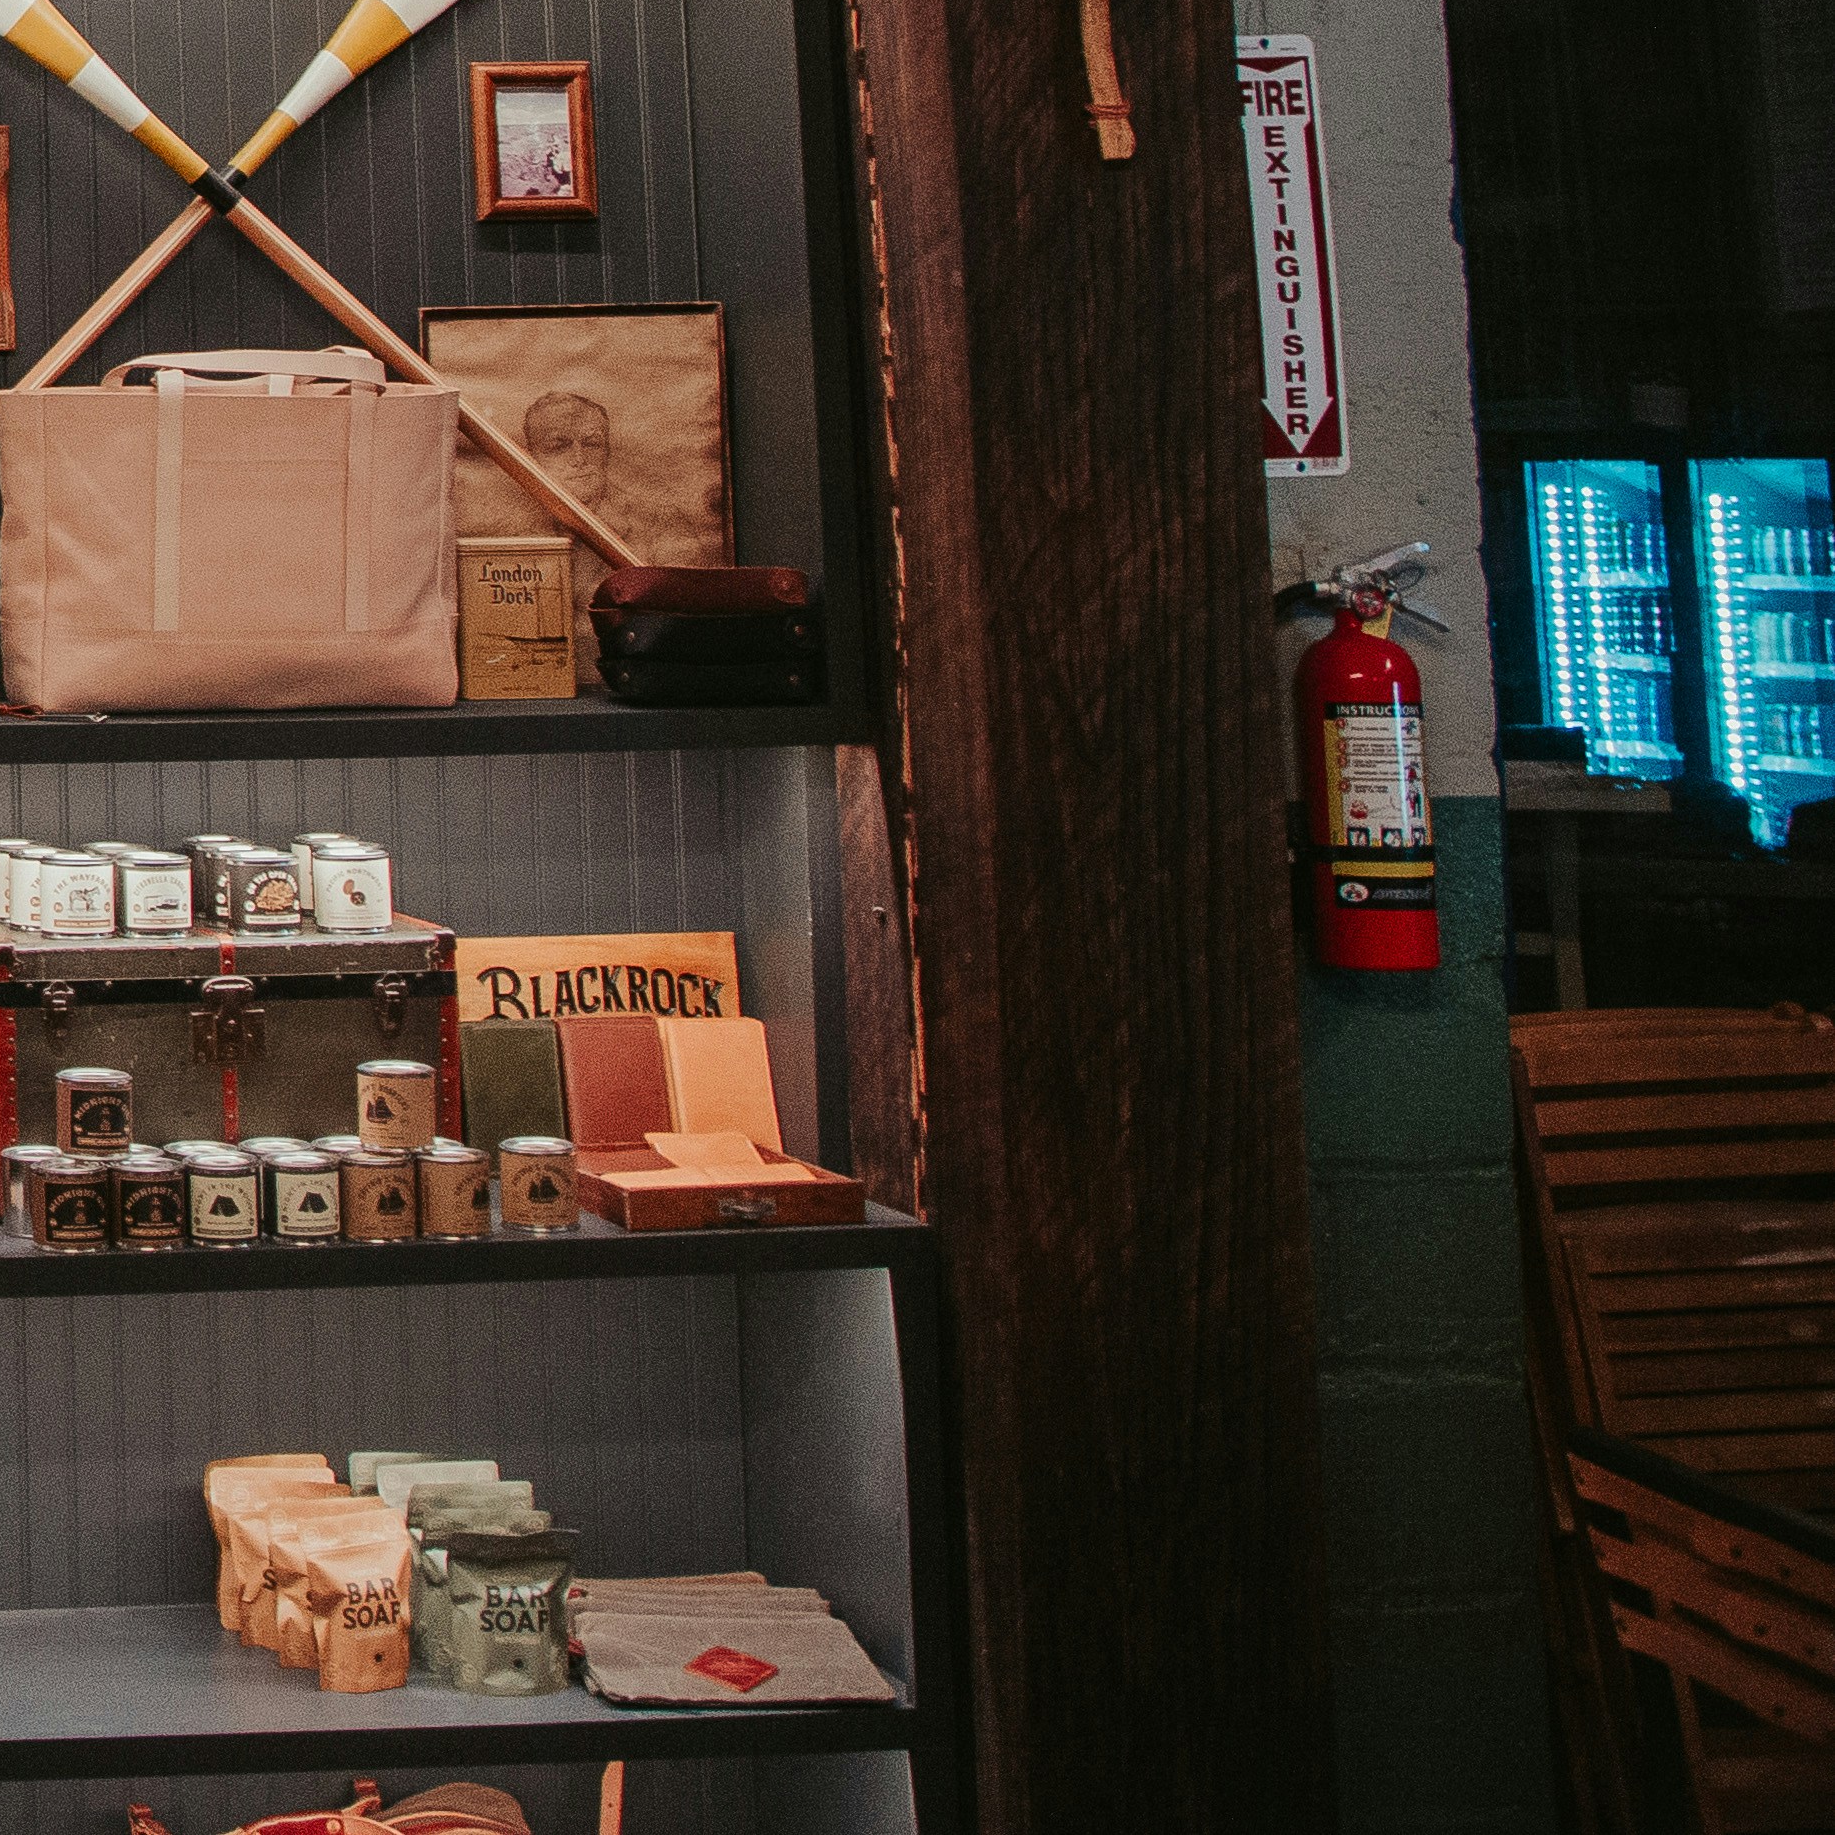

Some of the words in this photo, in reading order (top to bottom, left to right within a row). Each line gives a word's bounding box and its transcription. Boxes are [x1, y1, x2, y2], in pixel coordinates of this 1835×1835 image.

[1239, 79, 1306, 117] FIRE
[1263, 125, 1311, 437] EXTINGUISHER
[478, 561, 544, 583] London
[490, 584, 535, 605] Dock
[476, 965, 725, 1019] BLACKROCK
[73, 1096, 122, 1121] MIDNIGHT
[347, 1576, 398, 1604] BAR
[485, 1582, 546, 1610] BAR
[342, 1601, 401, 1632] SOAP
[478, 1608, 550, 1636] SOAP
